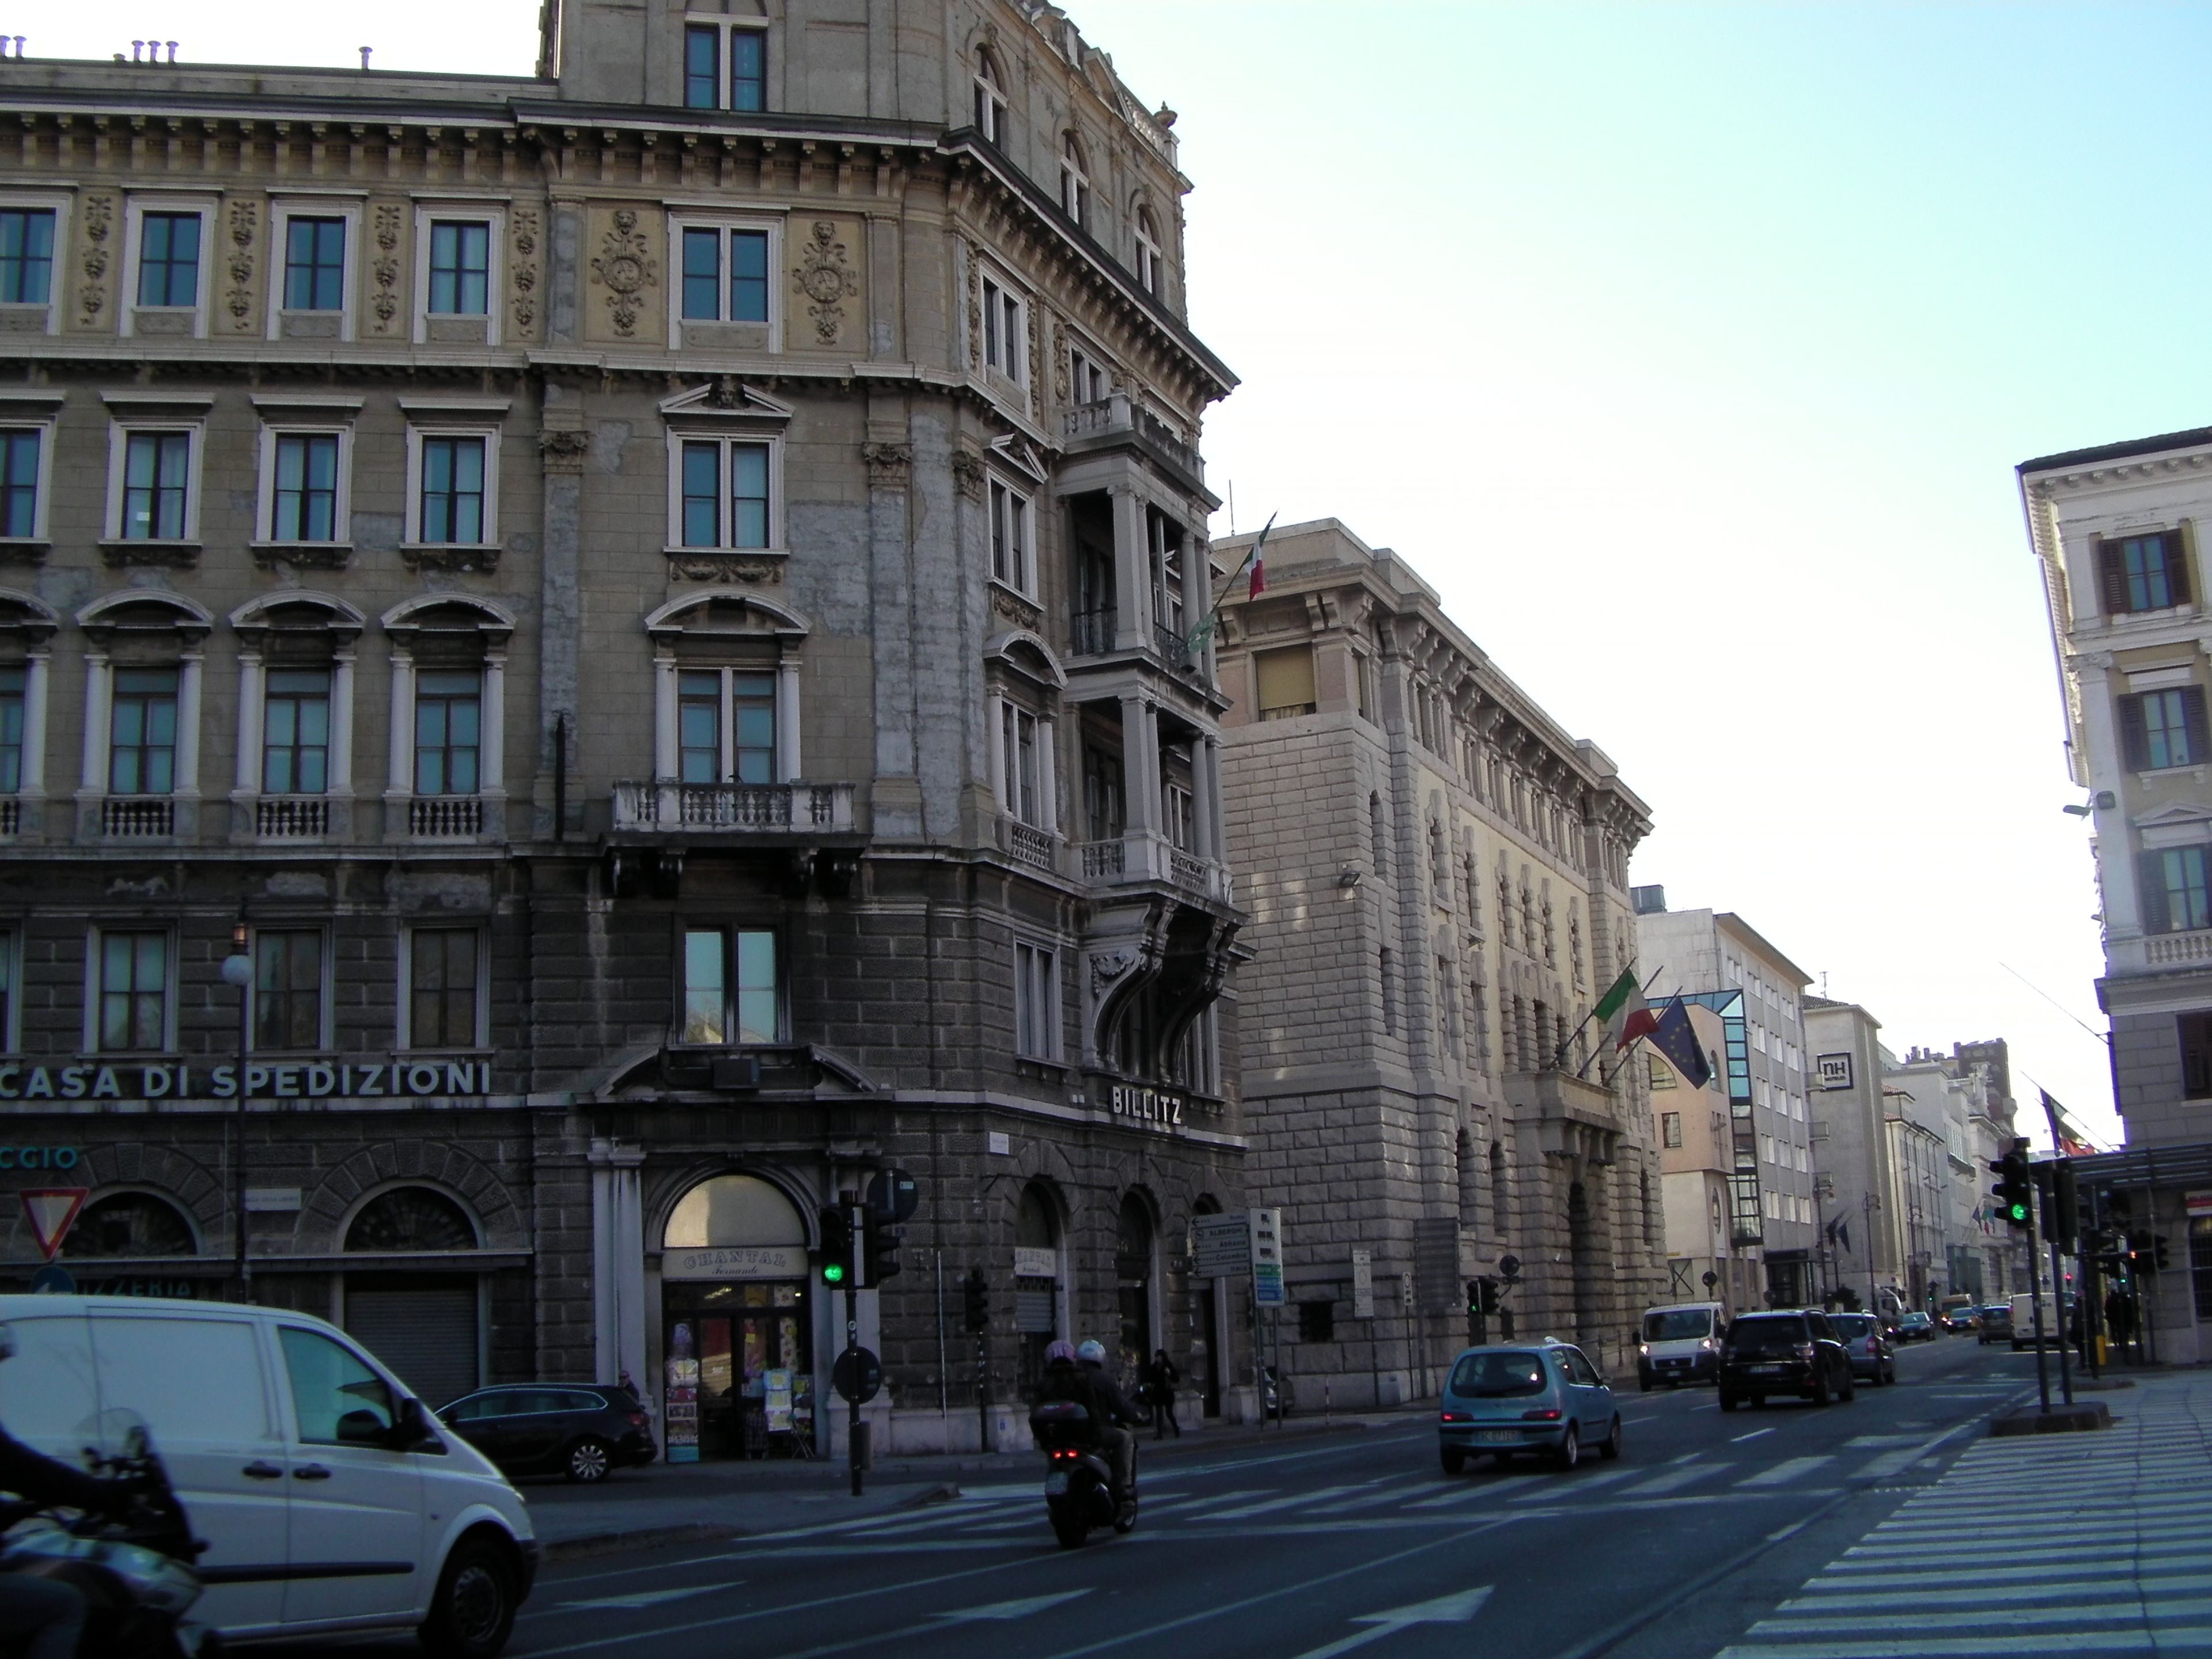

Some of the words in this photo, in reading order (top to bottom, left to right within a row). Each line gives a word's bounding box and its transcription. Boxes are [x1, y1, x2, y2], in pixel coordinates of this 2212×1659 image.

[0, 1066, 120, 1097] CASA
[143, 1066, 188, 1097] DI
[212, 1063, 490, 1097] SPEDIZIONI
[1112, 1086, 1181, 1124] BILLITZ
[684, 1251, 786, 1269] CHANTAL
[1215, 1253, 1247, 1261] Colombia
[75, 1278, 192, 1296] IZZERIA
